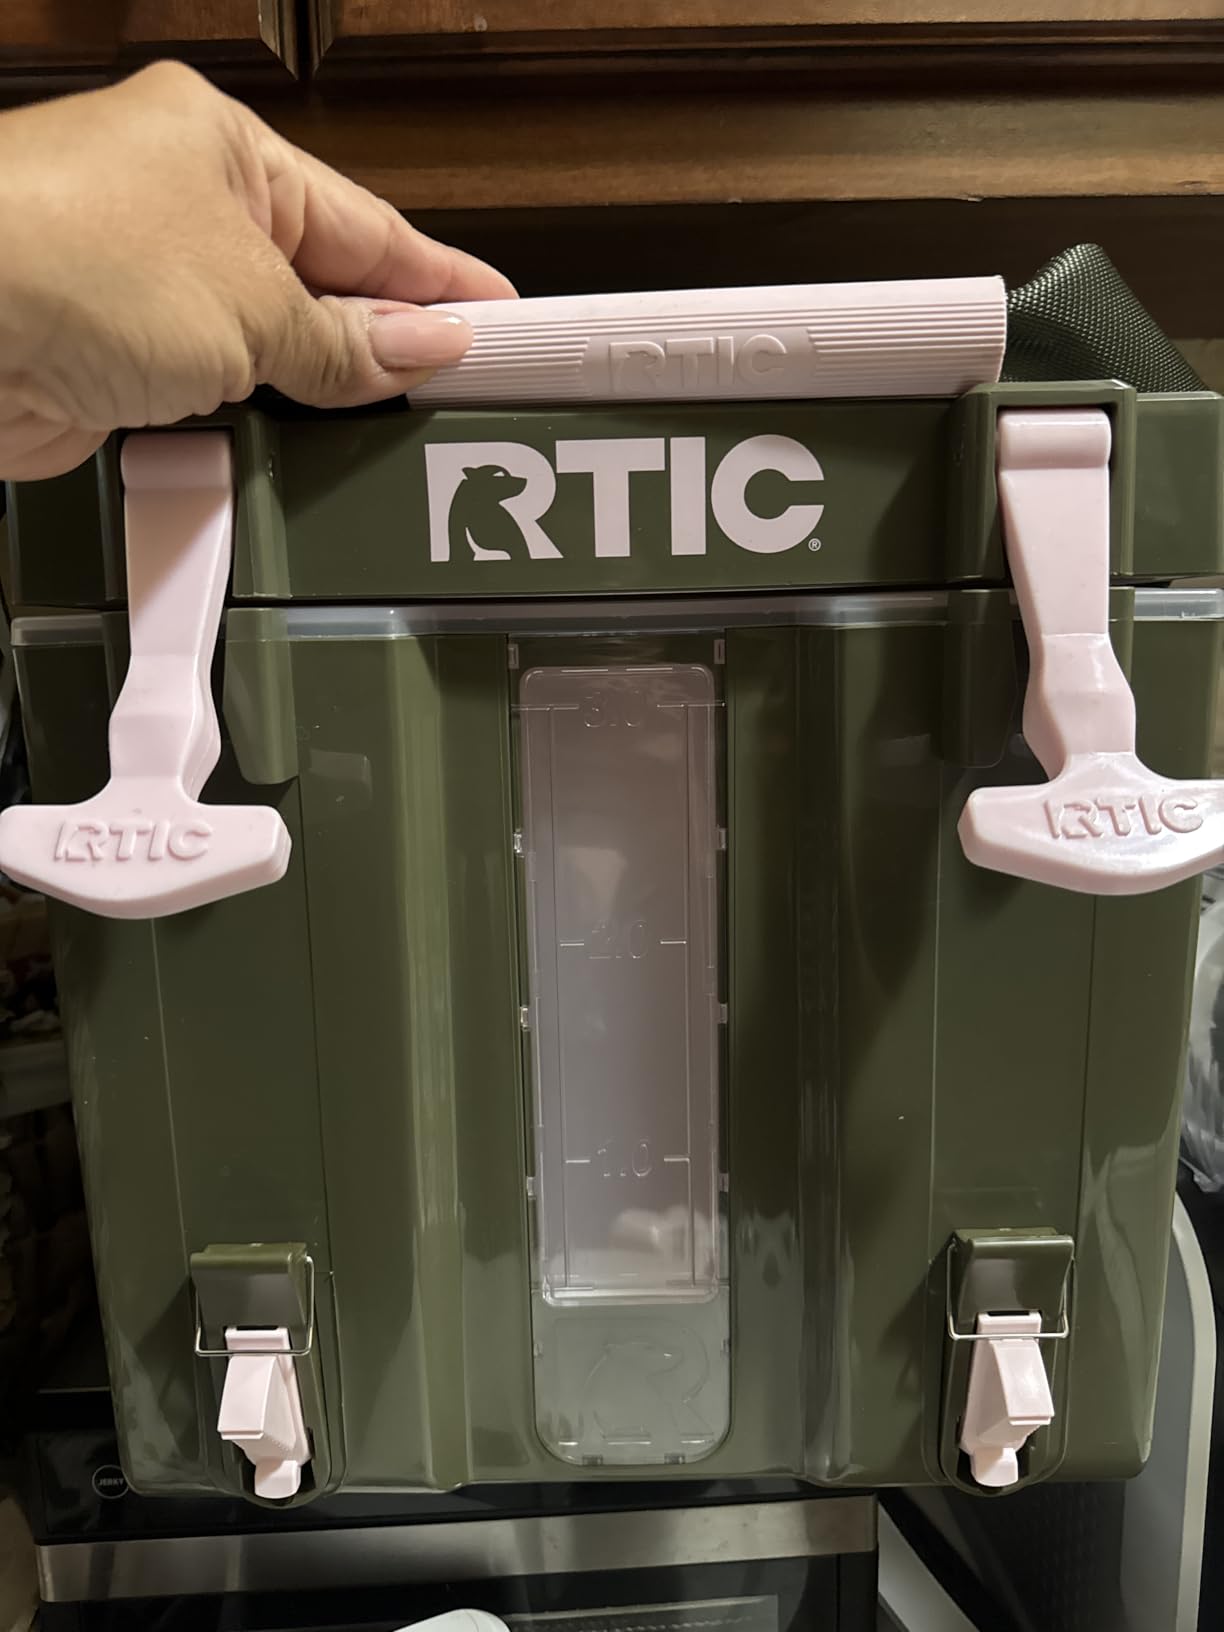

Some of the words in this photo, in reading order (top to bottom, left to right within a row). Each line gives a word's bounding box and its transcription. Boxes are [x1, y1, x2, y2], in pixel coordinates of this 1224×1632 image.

[608, 334, 788, 393] RTIC
[53, 818, 213, 864] RTIC
[1044, 796, 1204, 840] RTIC
